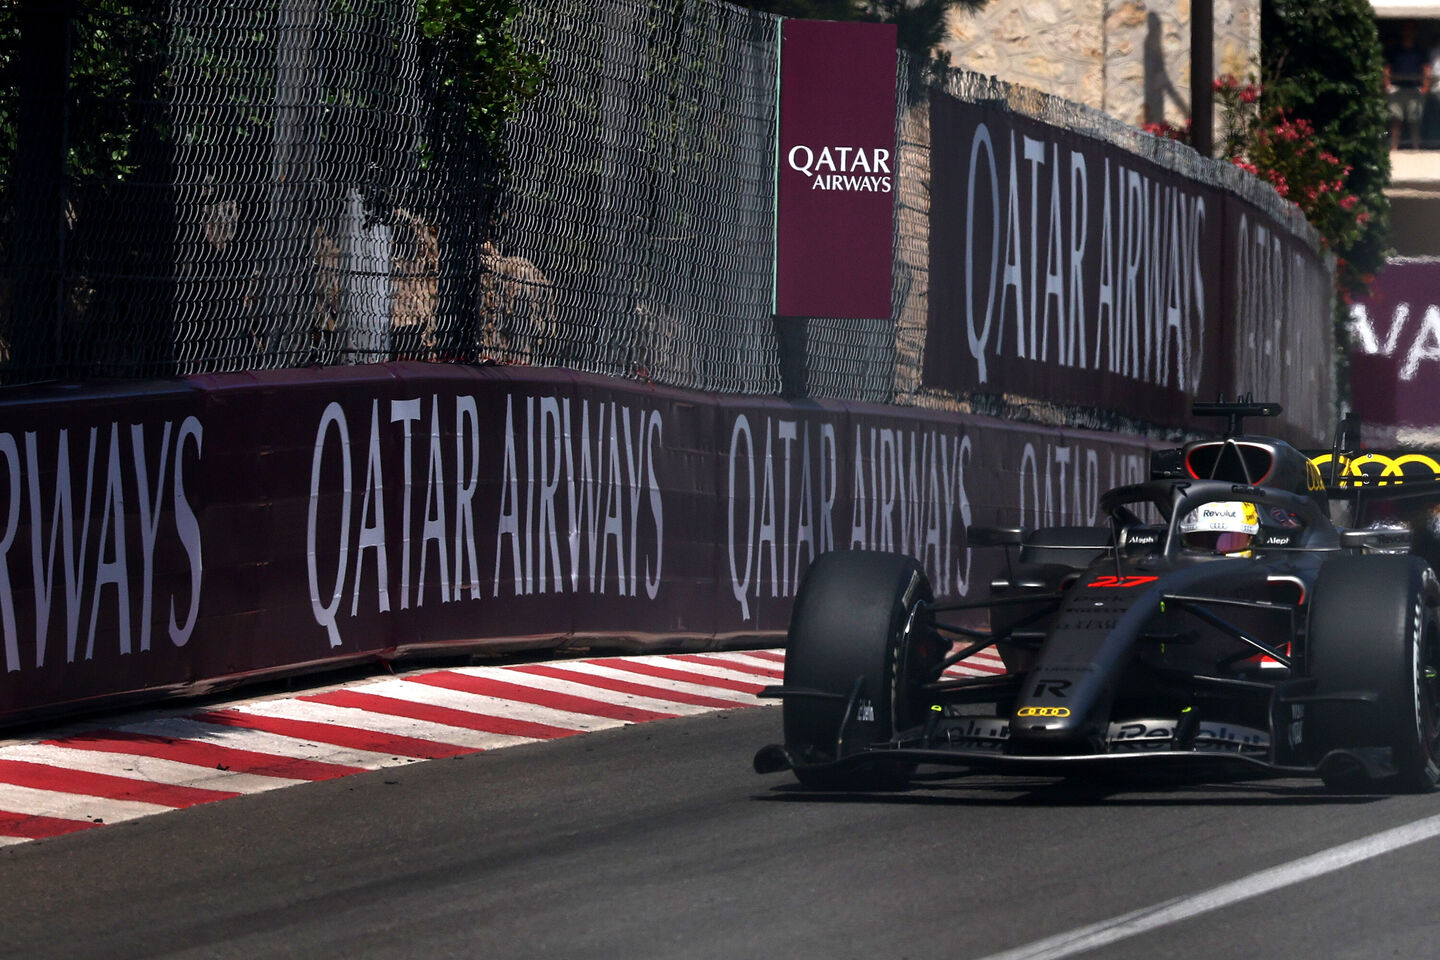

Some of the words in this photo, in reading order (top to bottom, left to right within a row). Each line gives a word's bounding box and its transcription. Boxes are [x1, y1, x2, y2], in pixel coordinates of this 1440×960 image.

[788, 145, 891, 177] QATAR
[812, 174, 891, 193] AIRWAYS
[966, 123, 1088, 384] QATAR
[1095, 157, 1206, 396] AIRWAYS
[307, 394, 481, 648] QATAR
[494, 394, 664, 601] AIRWAYS
[728, 413, 837, 621] QATAR
[850, 423, 973, 598] AIRWAYS
[1203, 509, 1236, 518] Revolut
[1087, 576, 1159, 587] 27
